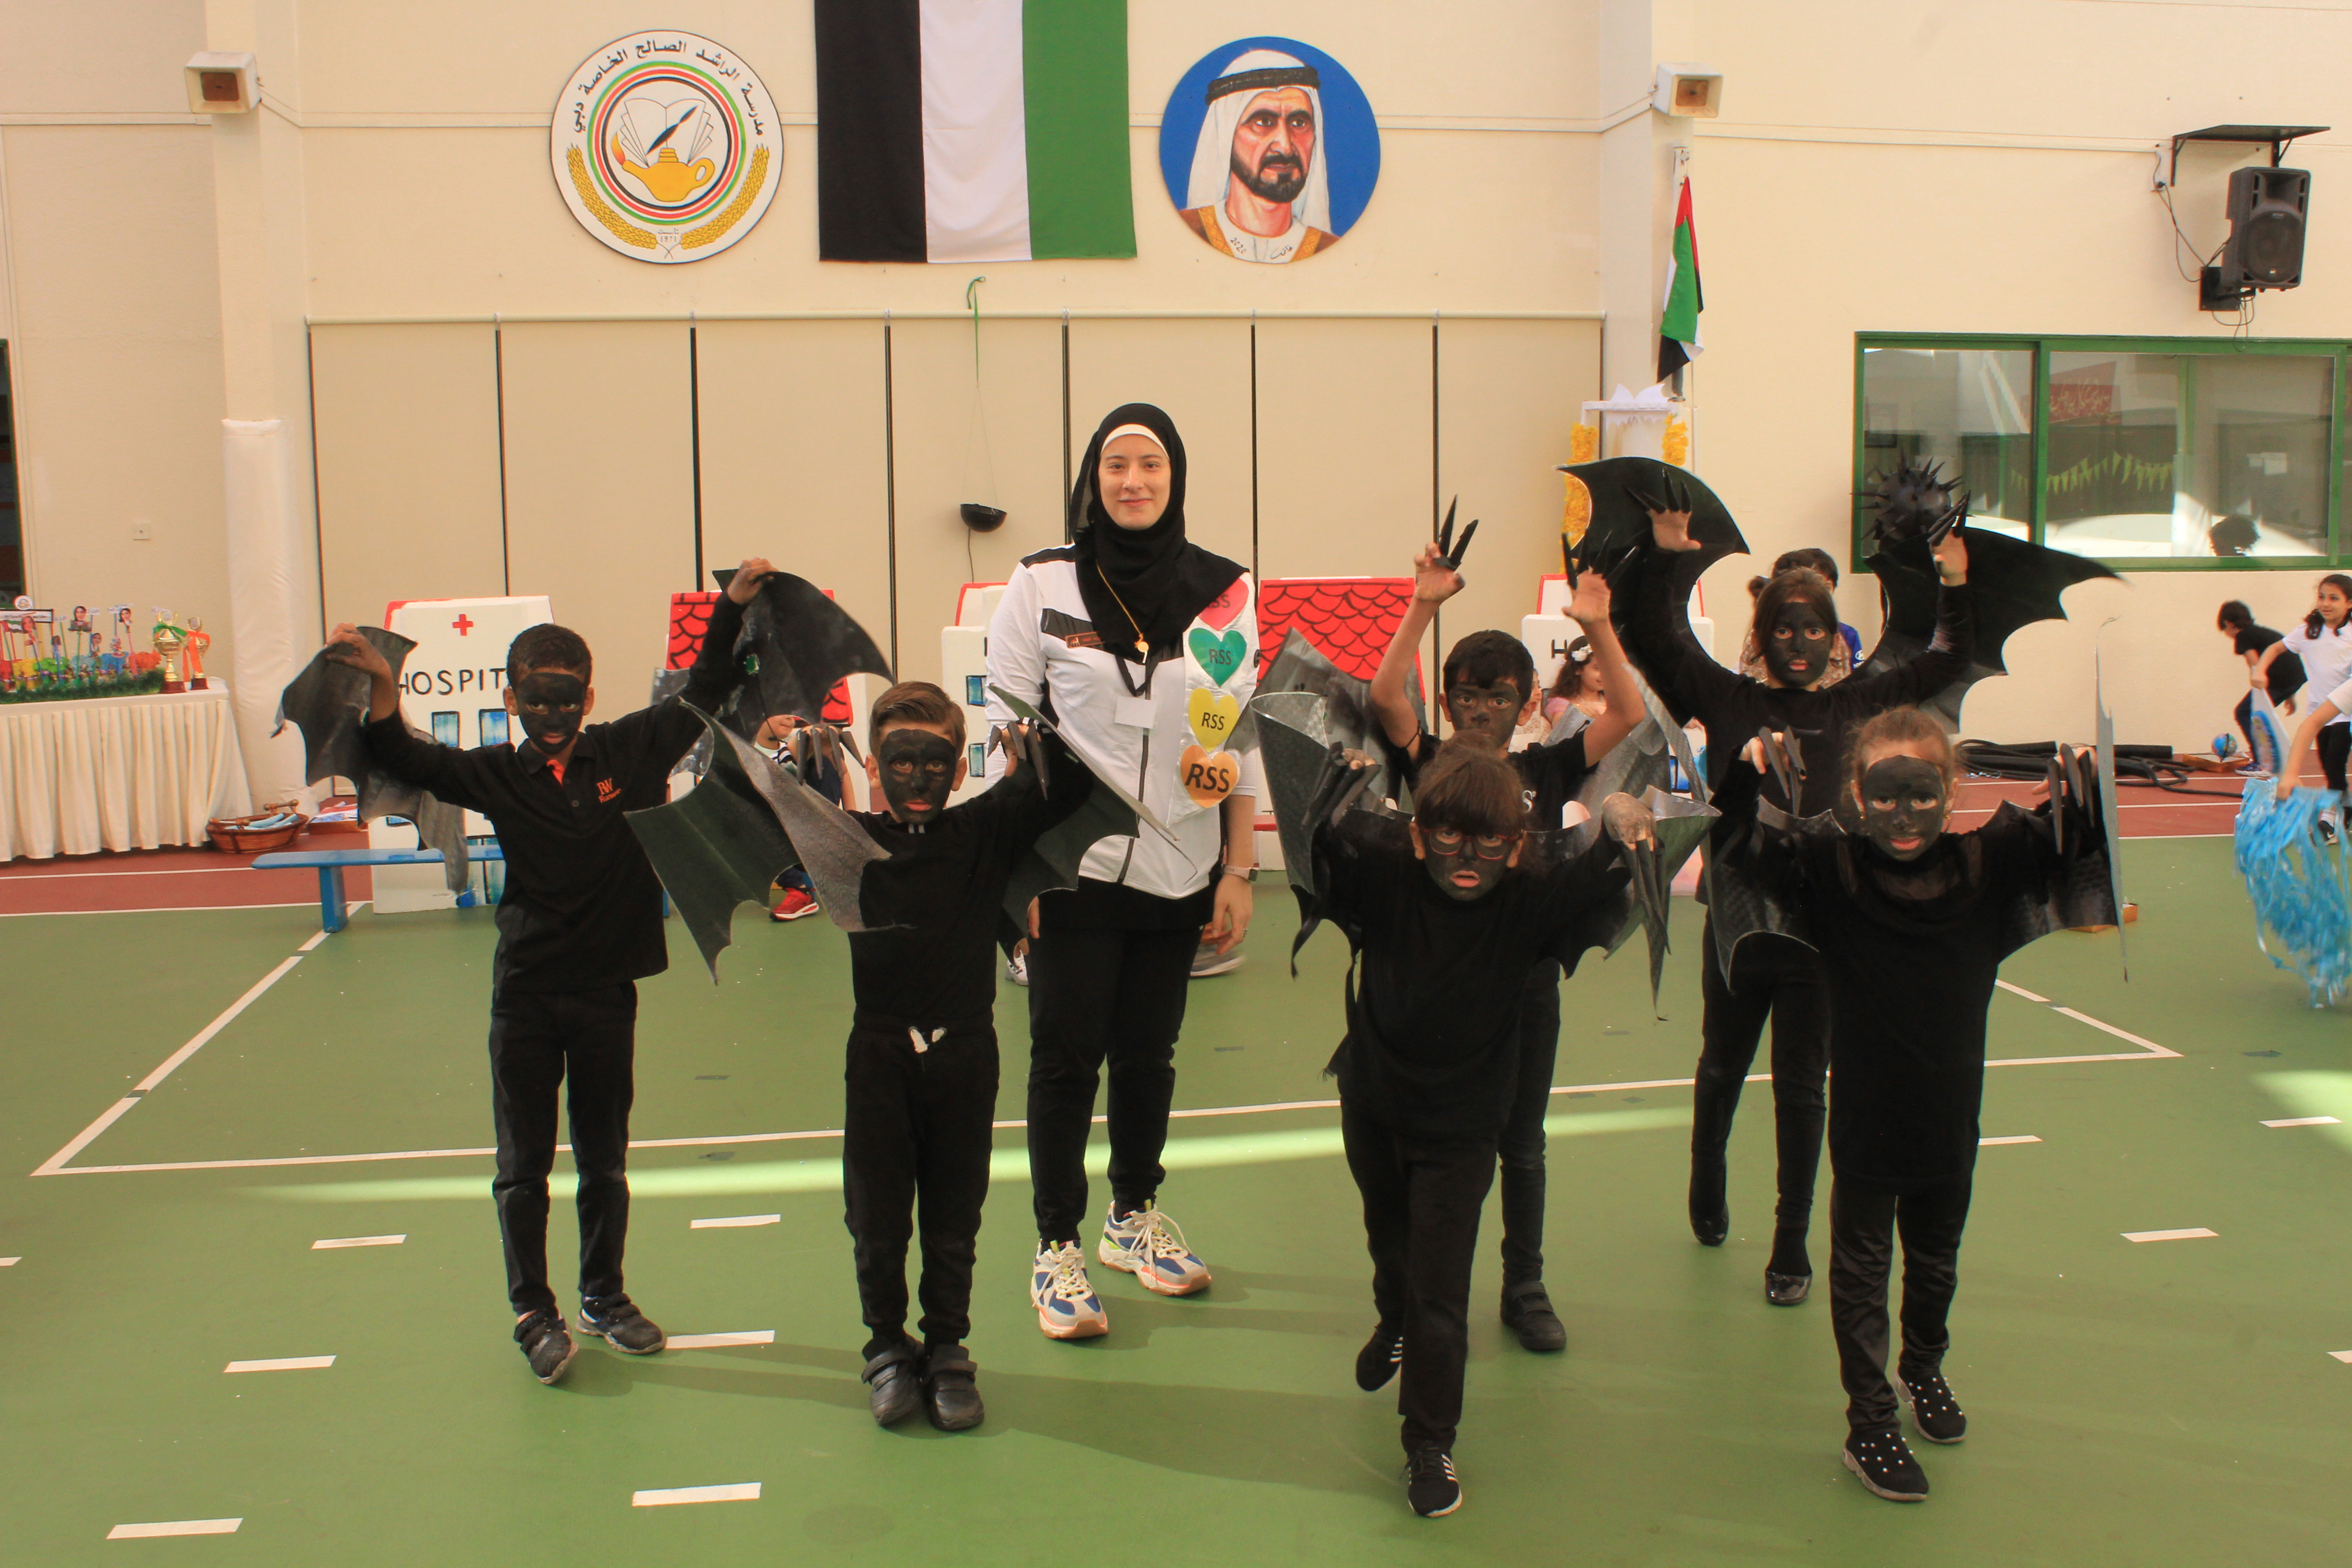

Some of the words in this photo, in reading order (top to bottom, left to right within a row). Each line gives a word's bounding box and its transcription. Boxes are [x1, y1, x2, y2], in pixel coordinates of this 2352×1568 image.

[636, 39, 687, 59] الصالح
[578, 49, 629, 96] الخاصة
[695, 49, 741, 81] الراشد
[573, 102, 586, 133] دبي
[740, 82, 764, 136] مدرسة
[1230, 237, 1246, 254] 2020
[1209, 649, 1232, 665] RSS
[398, 668, 507, 696] HOSPIT
[1201, 712, 1225, 730] RSS
[1185, 763, 1230, 793] RSS
